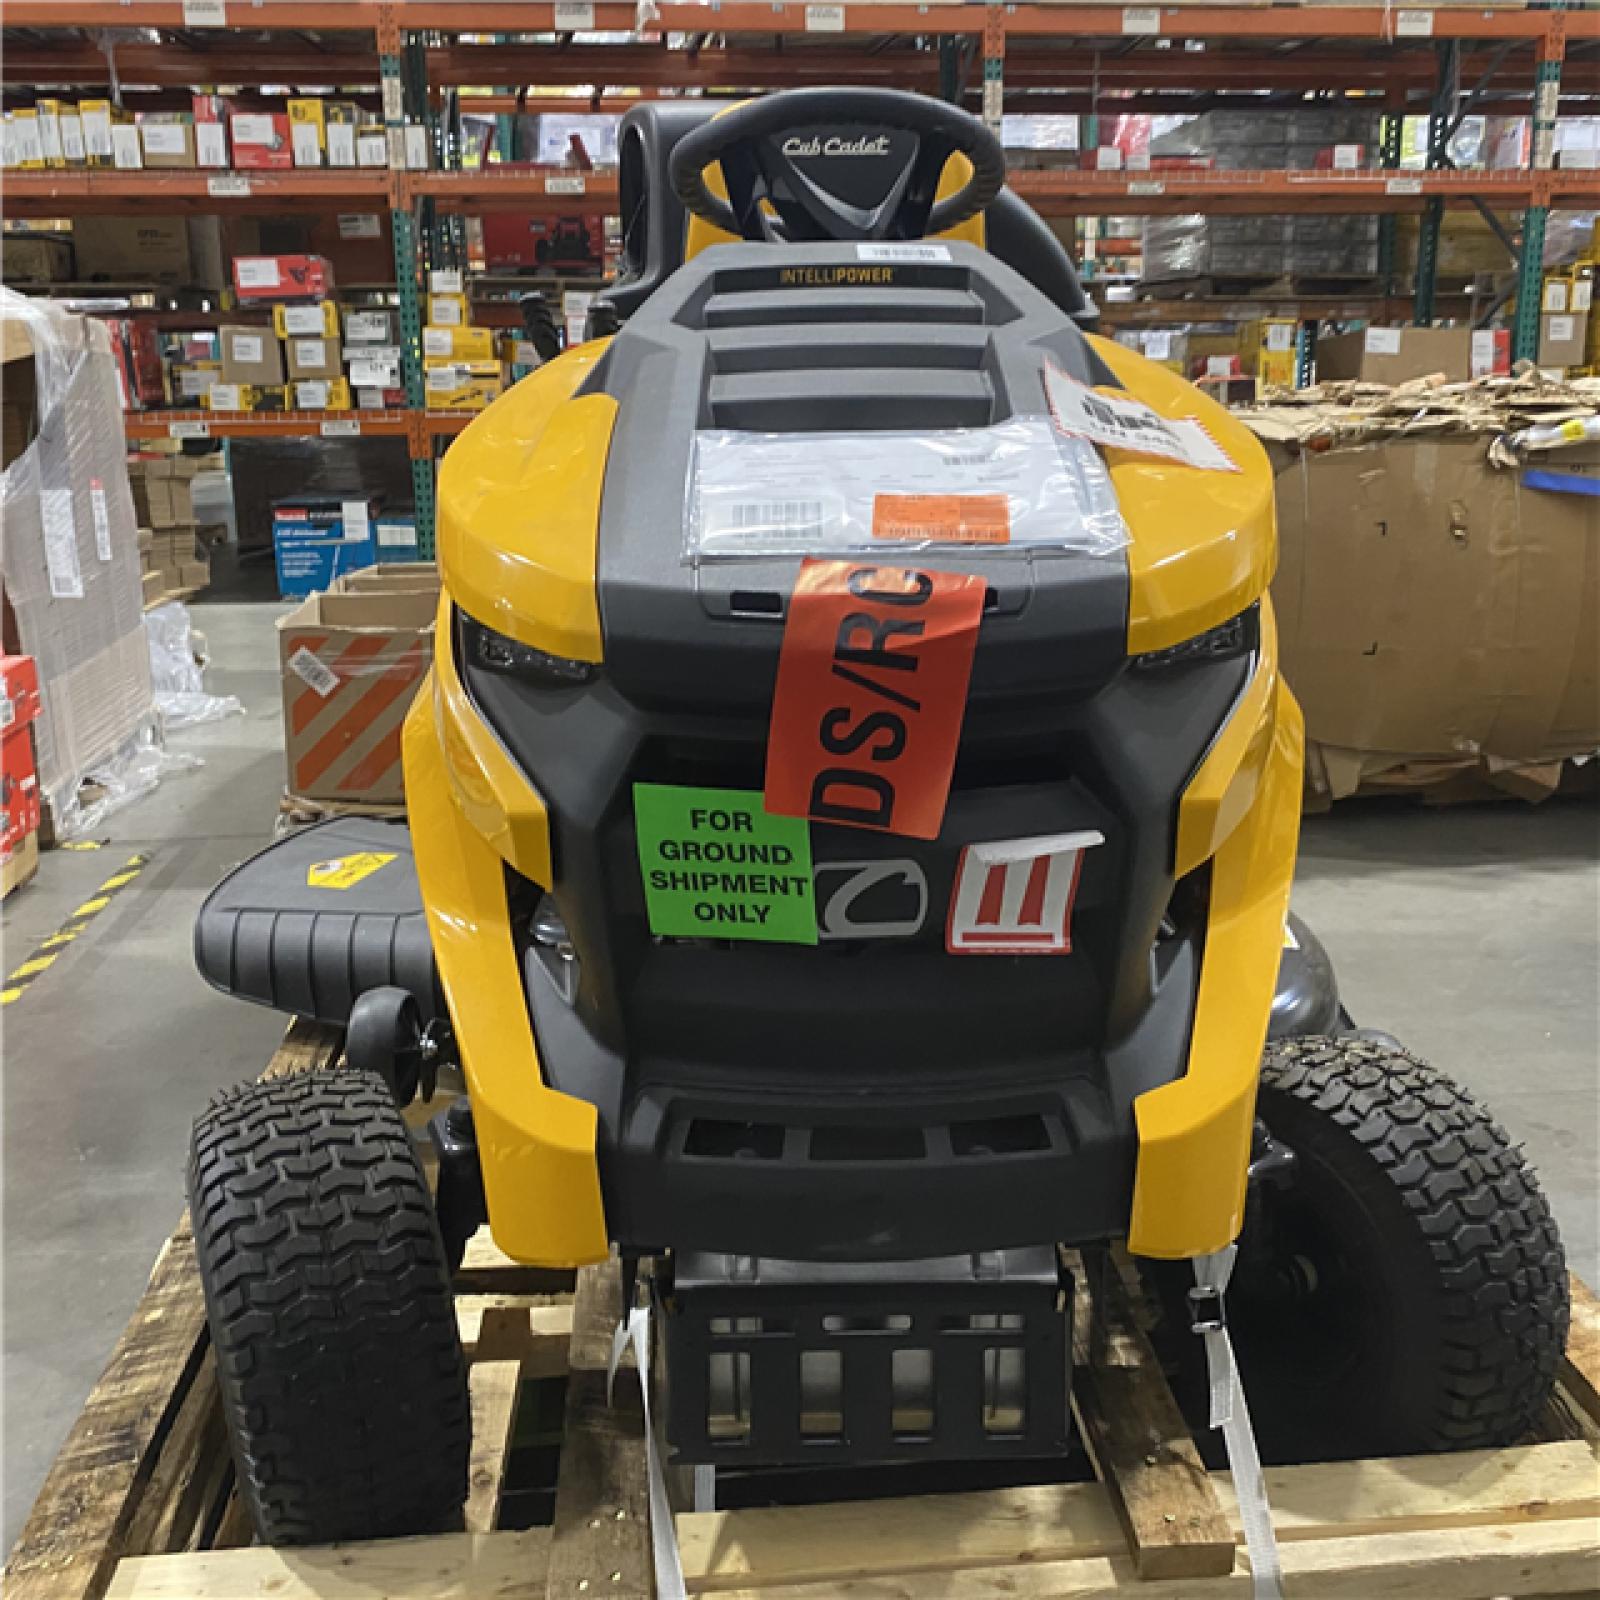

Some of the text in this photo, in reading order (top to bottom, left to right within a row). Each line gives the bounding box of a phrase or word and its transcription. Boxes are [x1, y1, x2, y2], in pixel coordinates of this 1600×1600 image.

[782, 135, 889, 155] Cub Cadet
[780, 268, 894, 284] INTELLIPOWER
[809, 567, 934, 828] DS/RC
[690, 809, 753, 833] FOR
[659, 840, 793, 866] GROUND
[650, 870, 808, 896] SHIPMENT
[694, 902, 771, 925] ONLY
